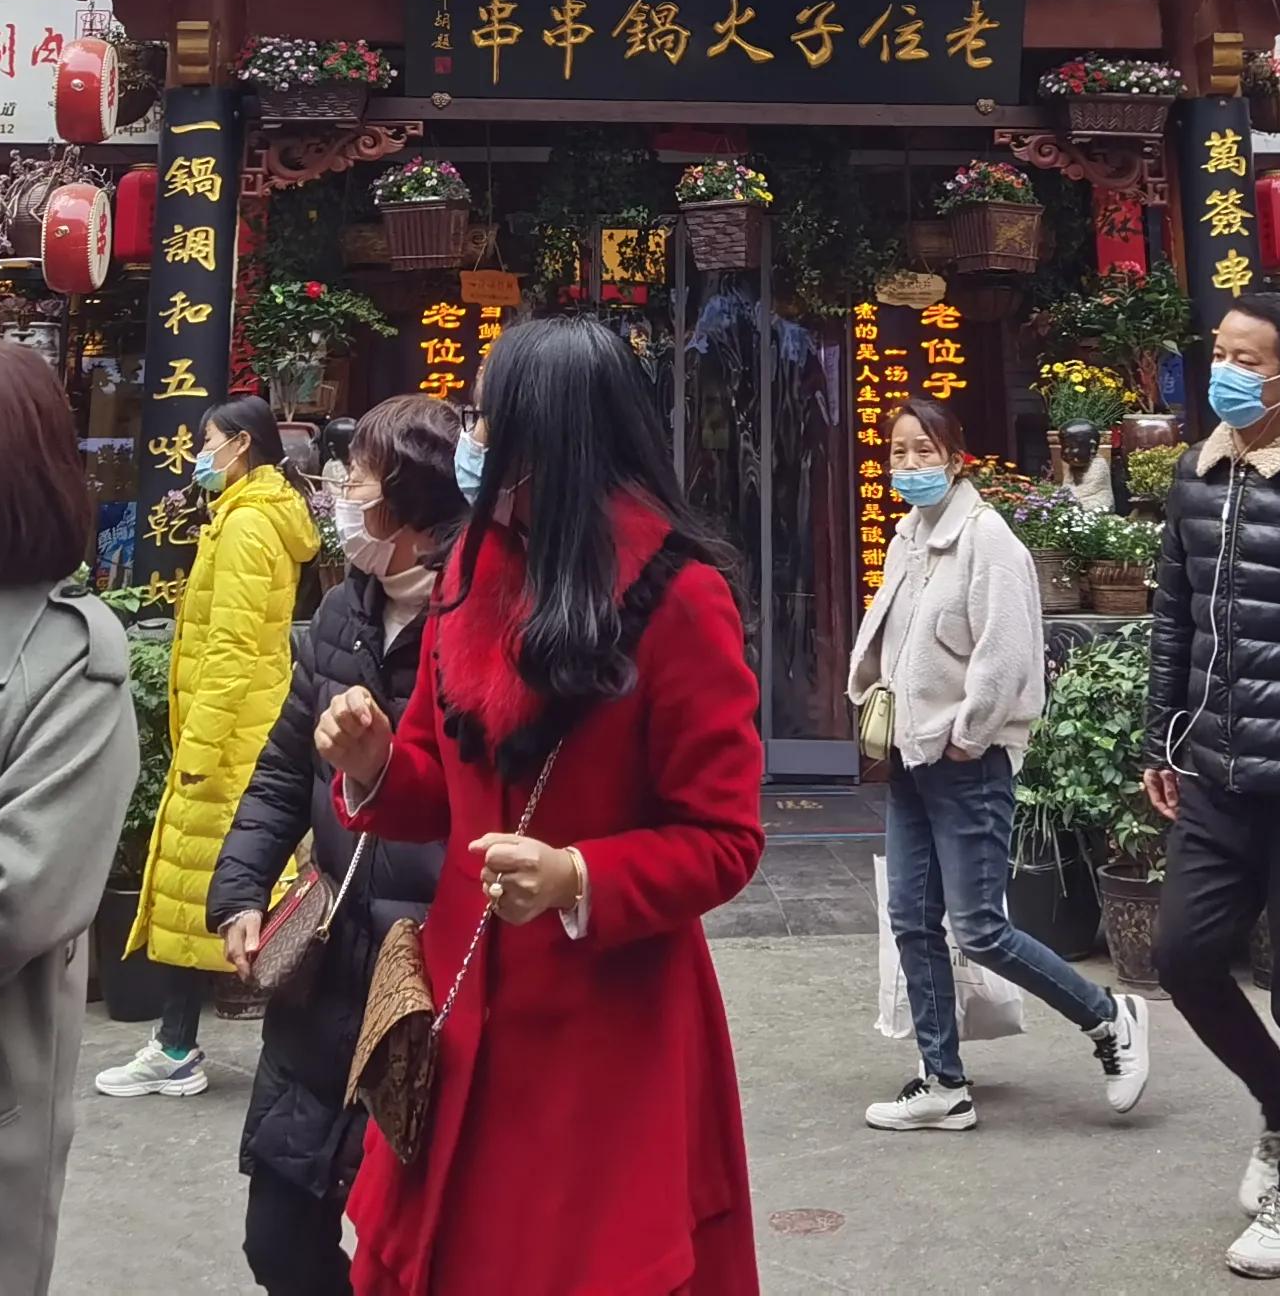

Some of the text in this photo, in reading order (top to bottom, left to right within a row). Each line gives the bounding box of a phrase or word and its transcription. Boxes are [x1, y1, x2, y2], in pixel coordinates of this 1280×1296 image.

[1200, 128, 1256, 300] 萬簽串
[420, 302, 466, 400] 老位子
[853, 302, 882, 446] 煮的是人生百味
[920, 303, 968, 400] 老位子
